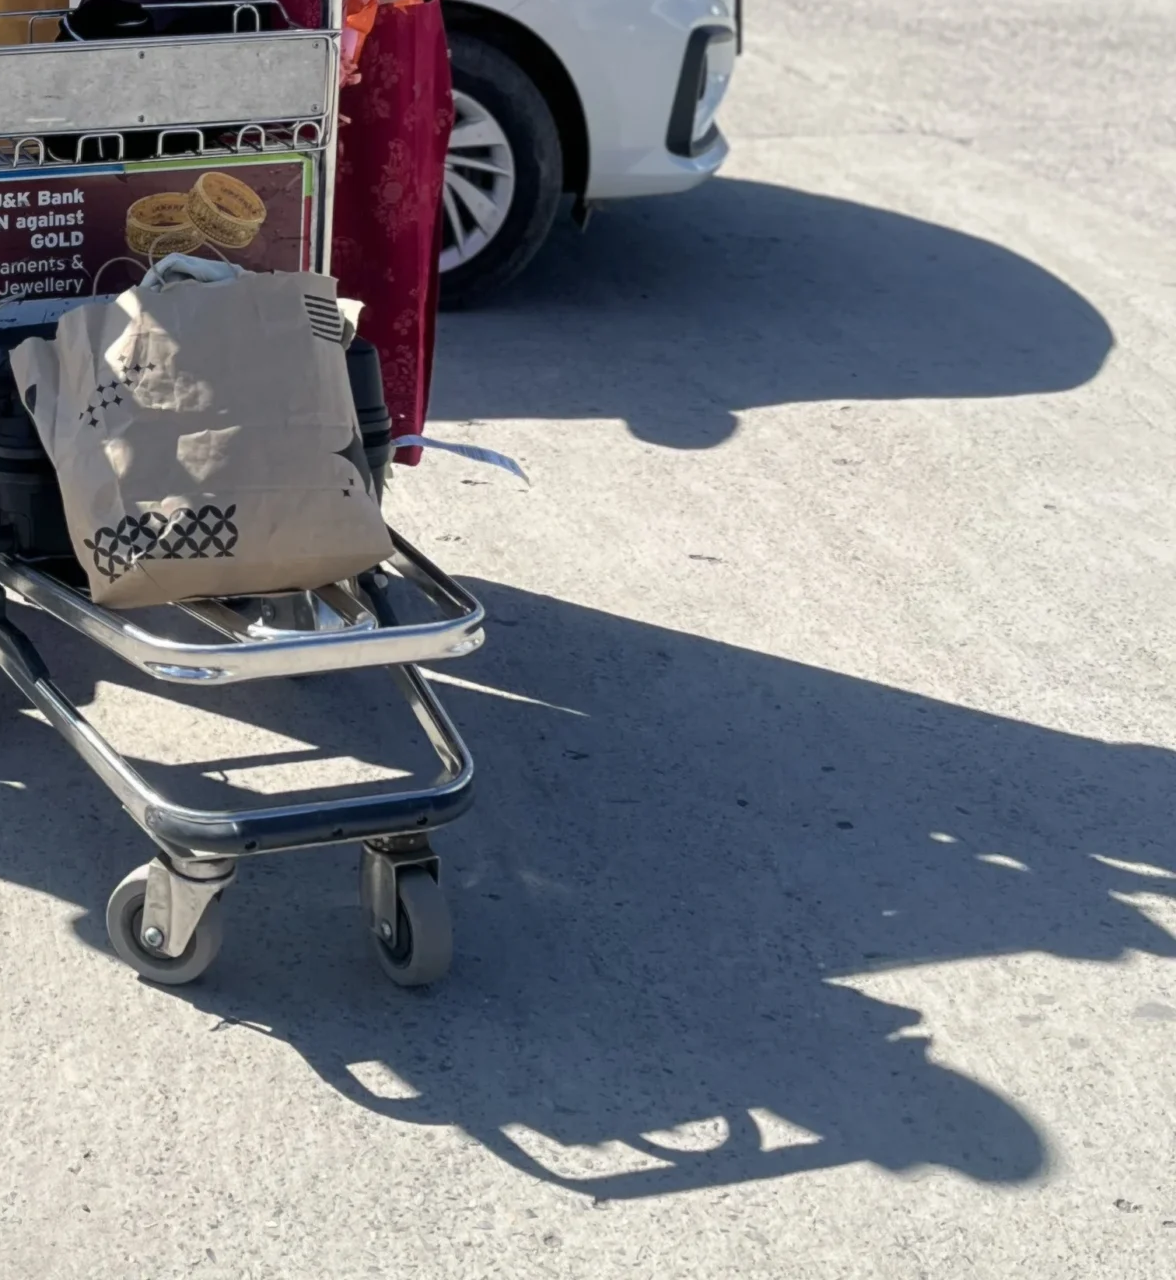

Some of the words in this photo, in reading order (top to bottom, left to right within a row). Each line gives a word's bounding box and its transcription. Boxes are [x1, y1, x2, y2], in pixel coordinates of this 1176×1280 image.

[37, 188, 85, 206] Bank
[15, 209, 84, 231] against
[30, 231, 84, 249] GOLD
[71, 254, 84, 270] &
